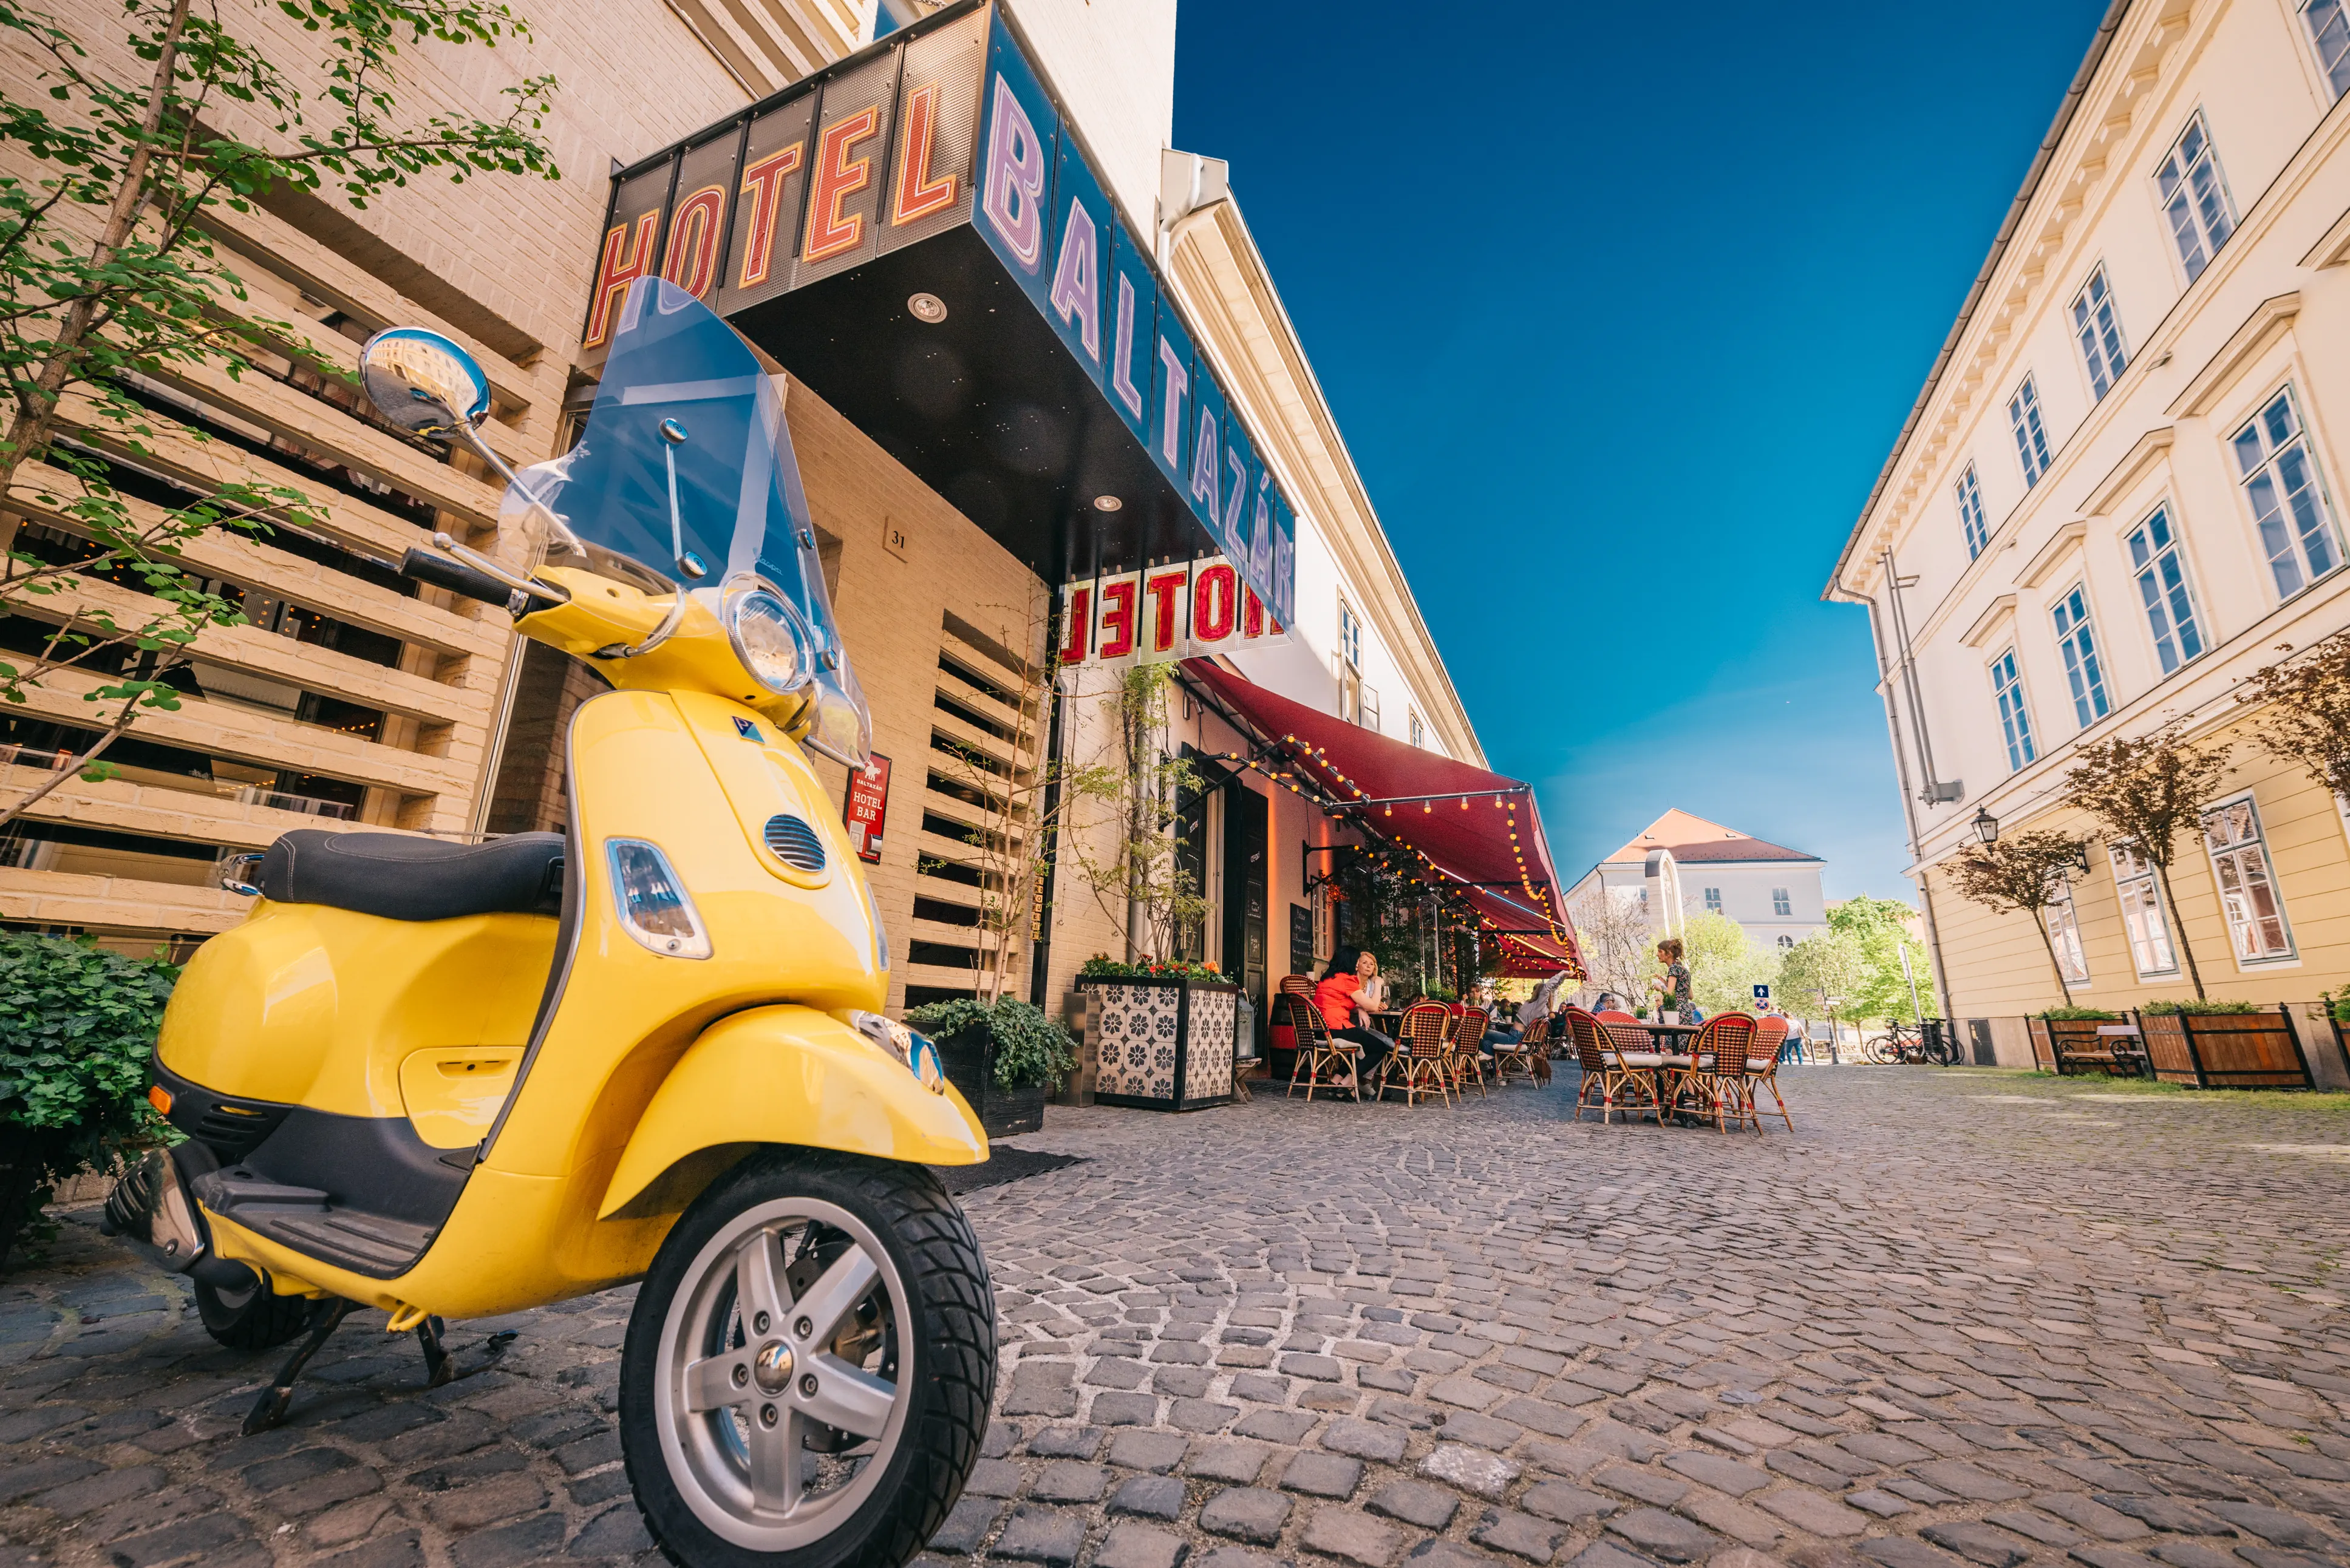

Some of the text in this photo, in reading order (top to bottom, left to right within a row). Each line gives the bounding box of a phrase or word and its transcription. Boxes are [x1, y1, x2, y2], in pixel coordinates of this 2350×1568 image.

[584, 72, 1292, 623] HOTEL BALTAZÁR
[891, 530, 904, 549] 31
[856, 778, 882, 792] BALTAZÁR
[853, 791, 882, 810] HOTEL
[857, 806, 876, 821] BAR
